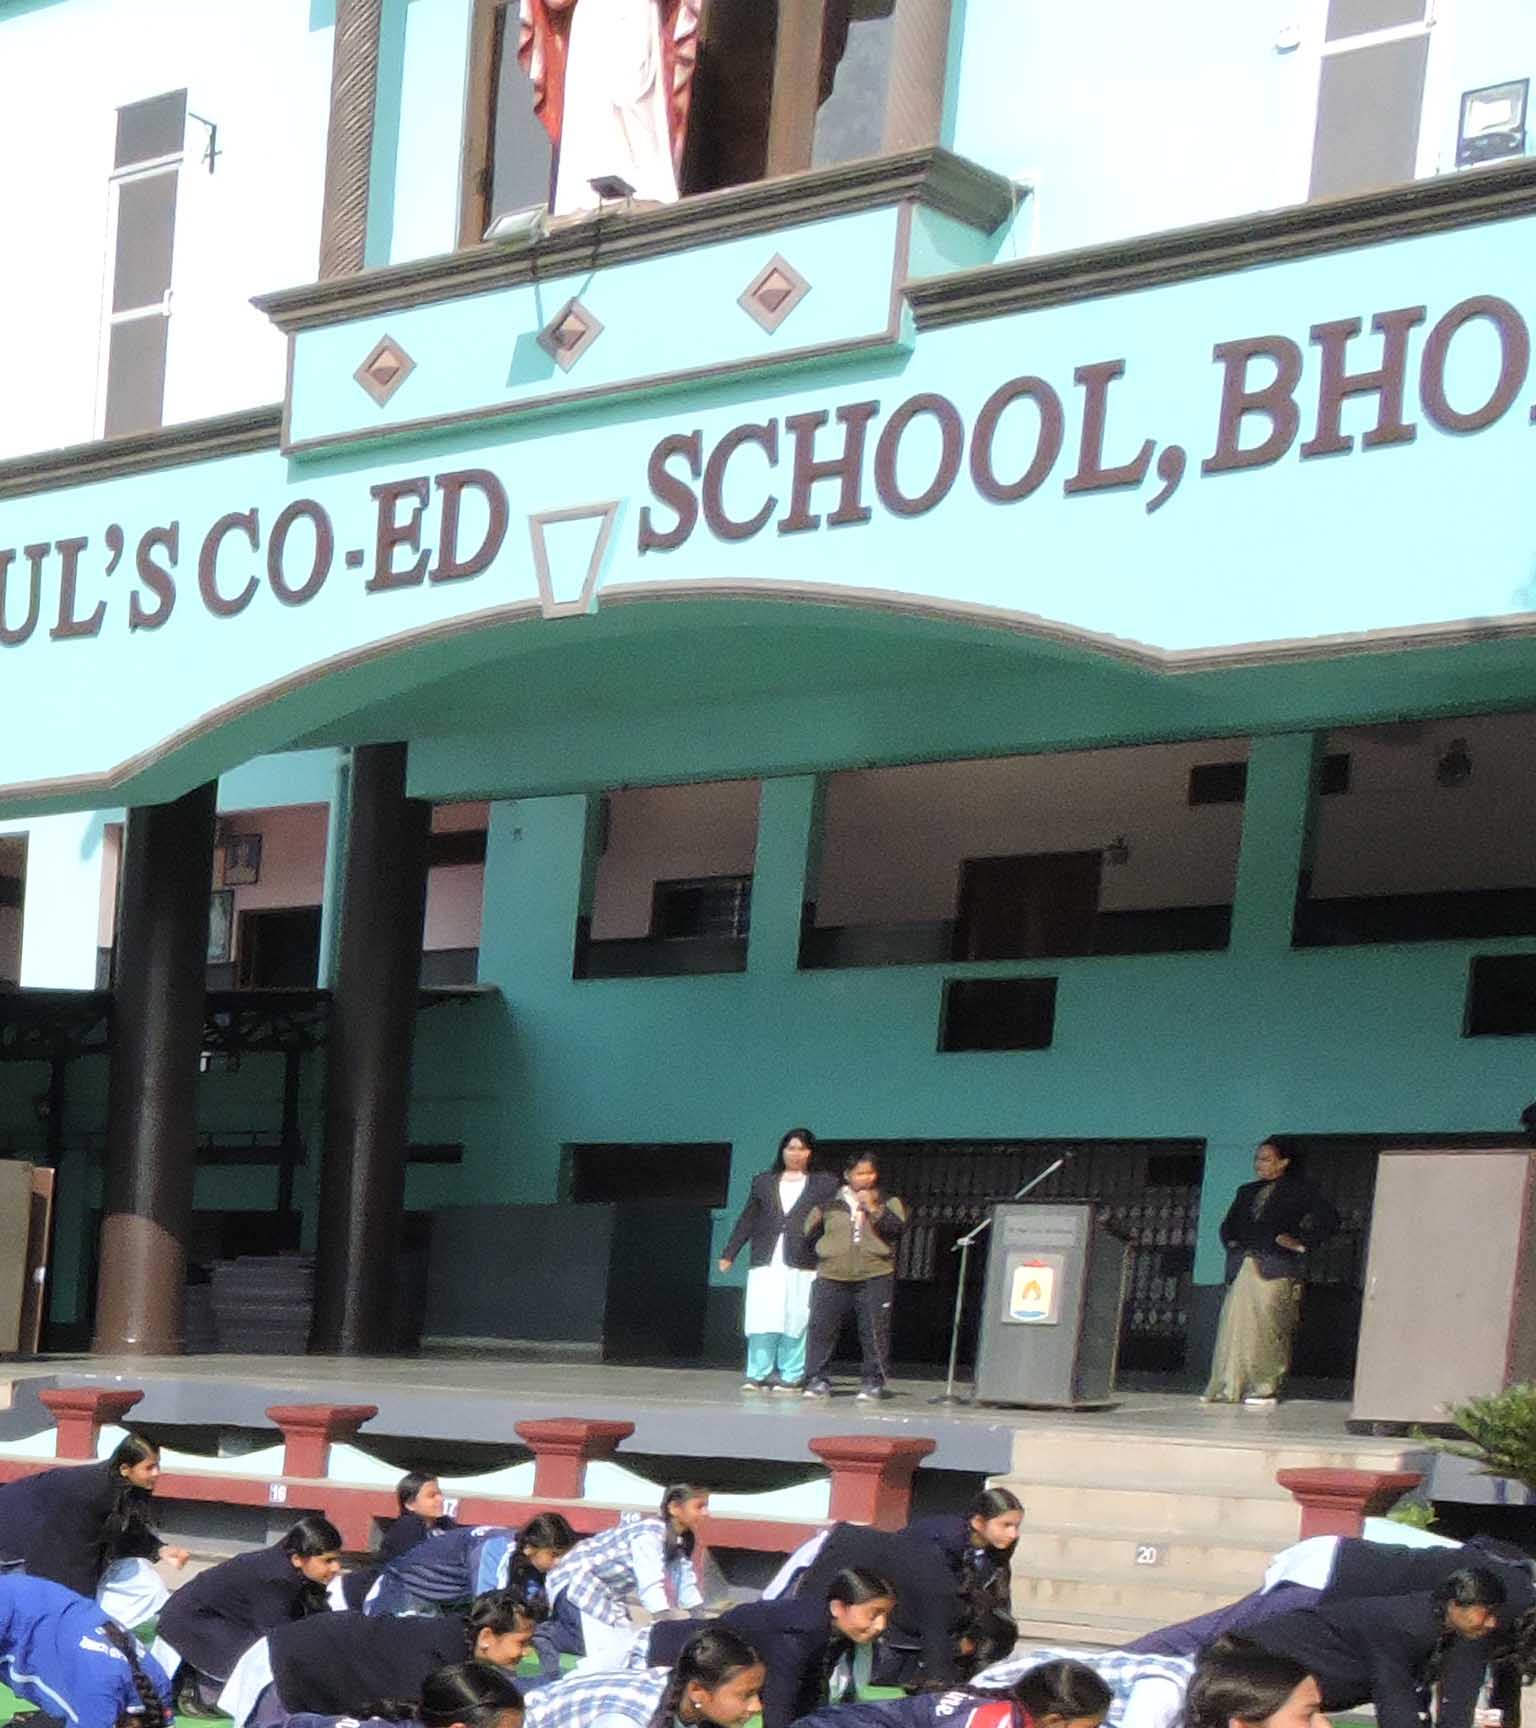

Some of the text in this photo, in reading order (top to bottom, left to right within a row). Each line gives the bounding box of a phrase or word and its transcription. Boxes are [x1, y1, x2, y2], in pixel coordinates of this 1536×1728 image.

[198, 470, 509, 618] CO-ED
[638, 358, 1187, 556] SCHOOL,
[1200, 294, 1536, 479] BHO
[1136, 1546, 1157, 1564] 20
